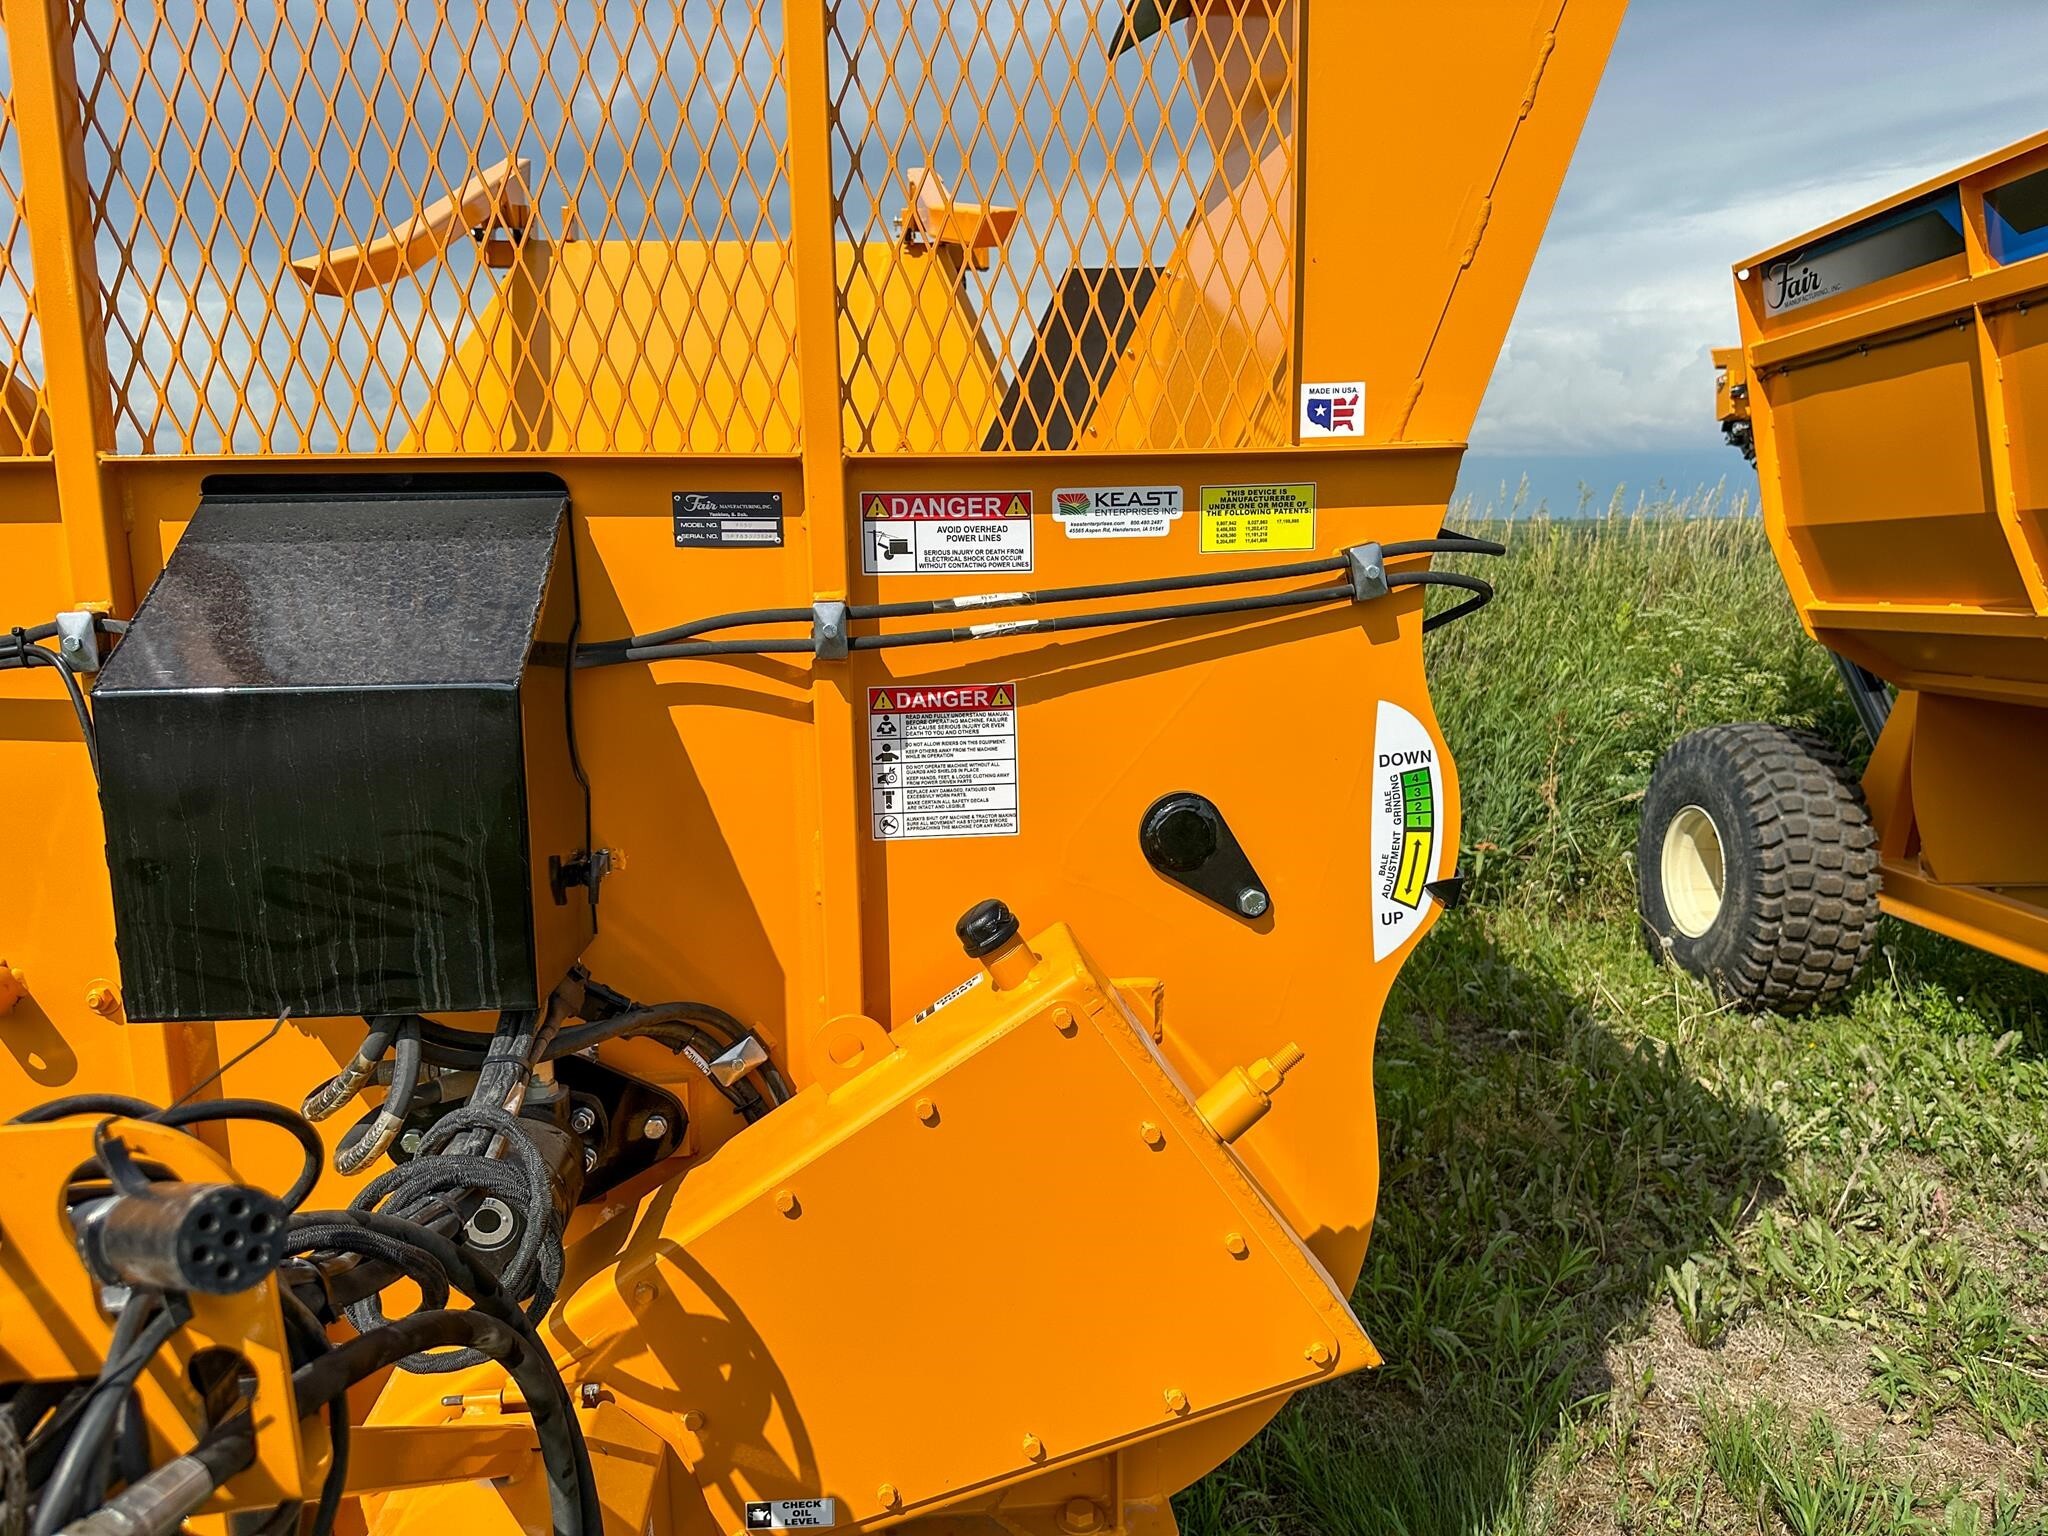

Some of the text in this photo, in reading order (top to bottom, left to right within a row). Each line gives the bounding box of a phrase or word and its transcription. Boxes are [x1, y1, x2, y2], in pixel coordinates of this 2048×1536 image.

[1768, 252, 1822, 309] Fair
[684, 494, 718, 511] Fair
[892, 498, 1004, 517] DANGER
[1095, 491, 1178, 507] KEAST
[1095, 508, 1159, 516] ENTERPRISES
[896, 690, 989, 708] DANGER
[1379, 750, 1431, 768] DOWN
[1412, 774, 1419, 782] 4
[1390, 774, 1401, 825] GRINDING
[1414, 788, 1421, 797] 3
[1384, 791, 1392, 813] BALE
[1415, 802, 1422, 811] 2
[1416, 816, 1421, 825] 1
[1379, 854, 1389, 876] BALE
[1382, 831, 1400, 899] ADJUSTMENT
[1382, 912, 1403, 925] UP
[782, 1500, 821, 1509] CHECK
